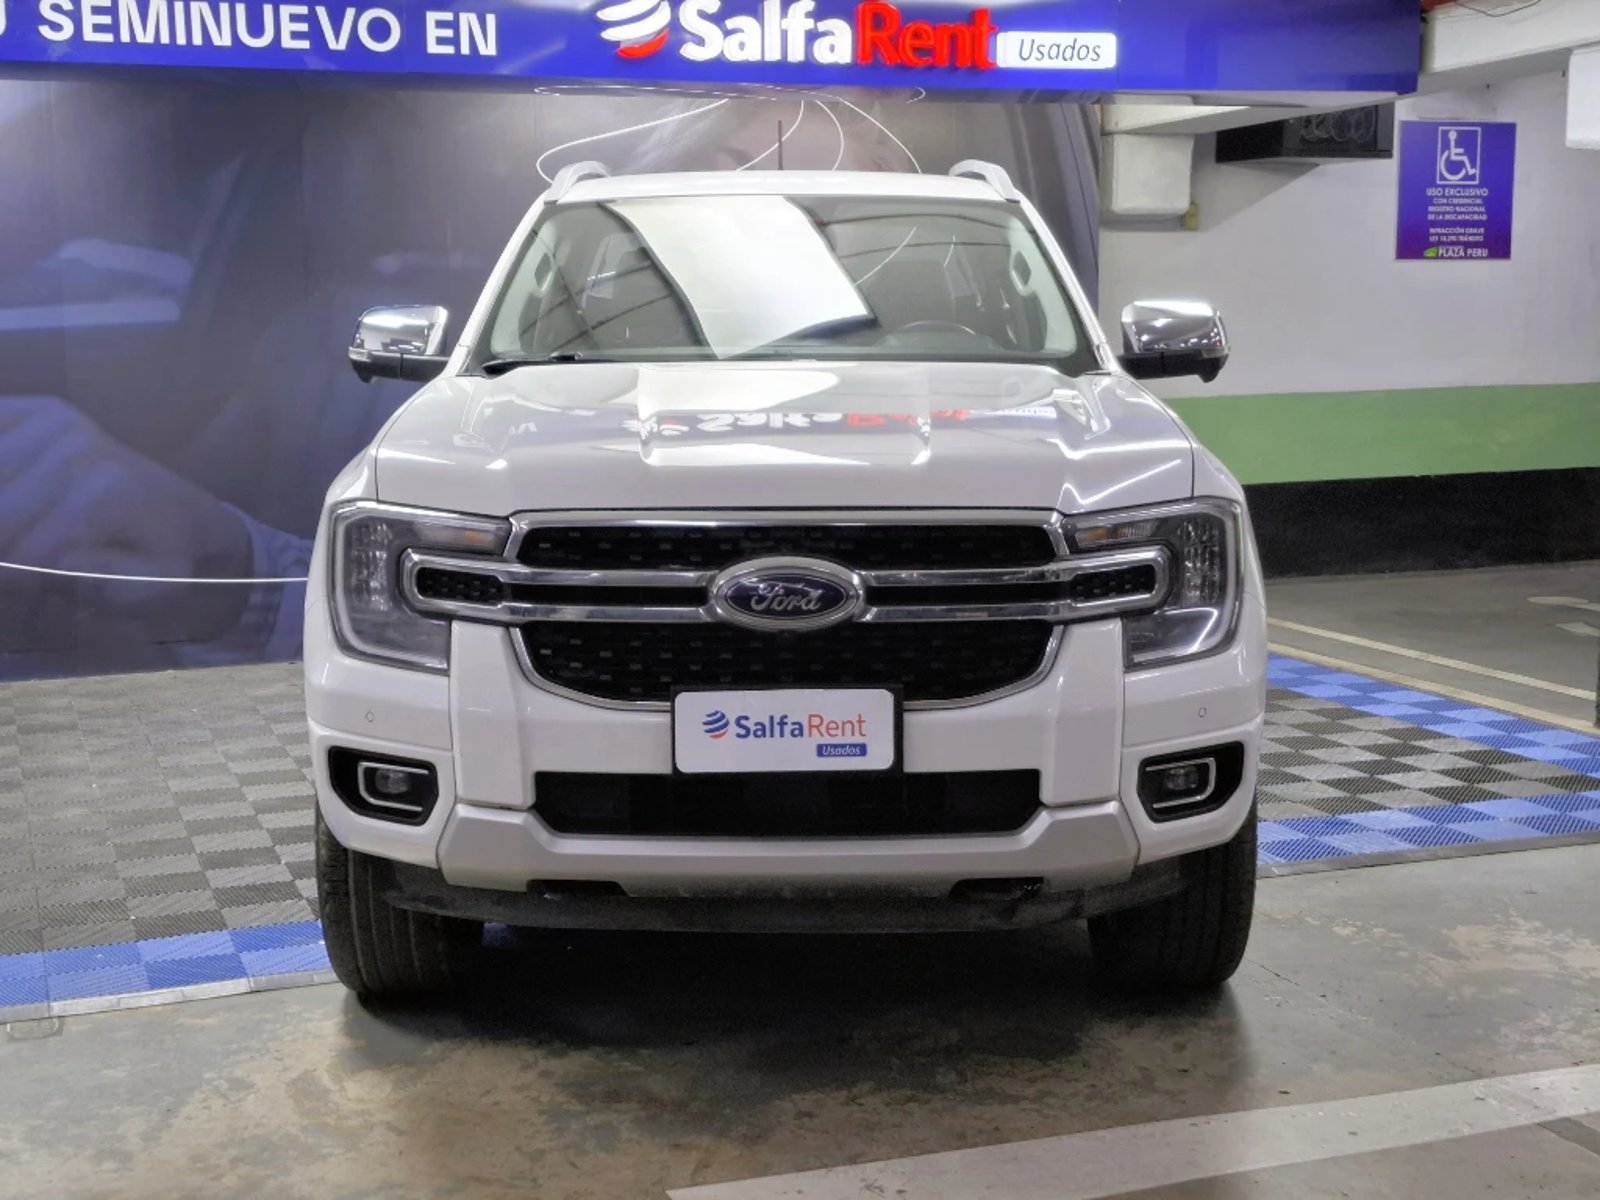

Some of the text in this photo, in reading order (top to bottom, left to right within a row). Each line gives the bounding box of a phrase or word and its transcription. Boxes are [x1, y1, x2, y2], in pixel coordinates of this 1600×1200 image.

[38, 0, 401, 53] SEMINUEVO
[426, 11, 497, 56] EN
[678, 0, 998, 69] SalfaRent
[1018, 36, 1102, 63] Usados
[1426, 187, 1489, 196] USO EXCLUSIVO
[1439, 247, 1488, 257] PLAZA PERU
[750, 583, 825, 612] Ford
[734, 713, 867, 740] SalfaRent
[821, 745, 862, 756] Usados
